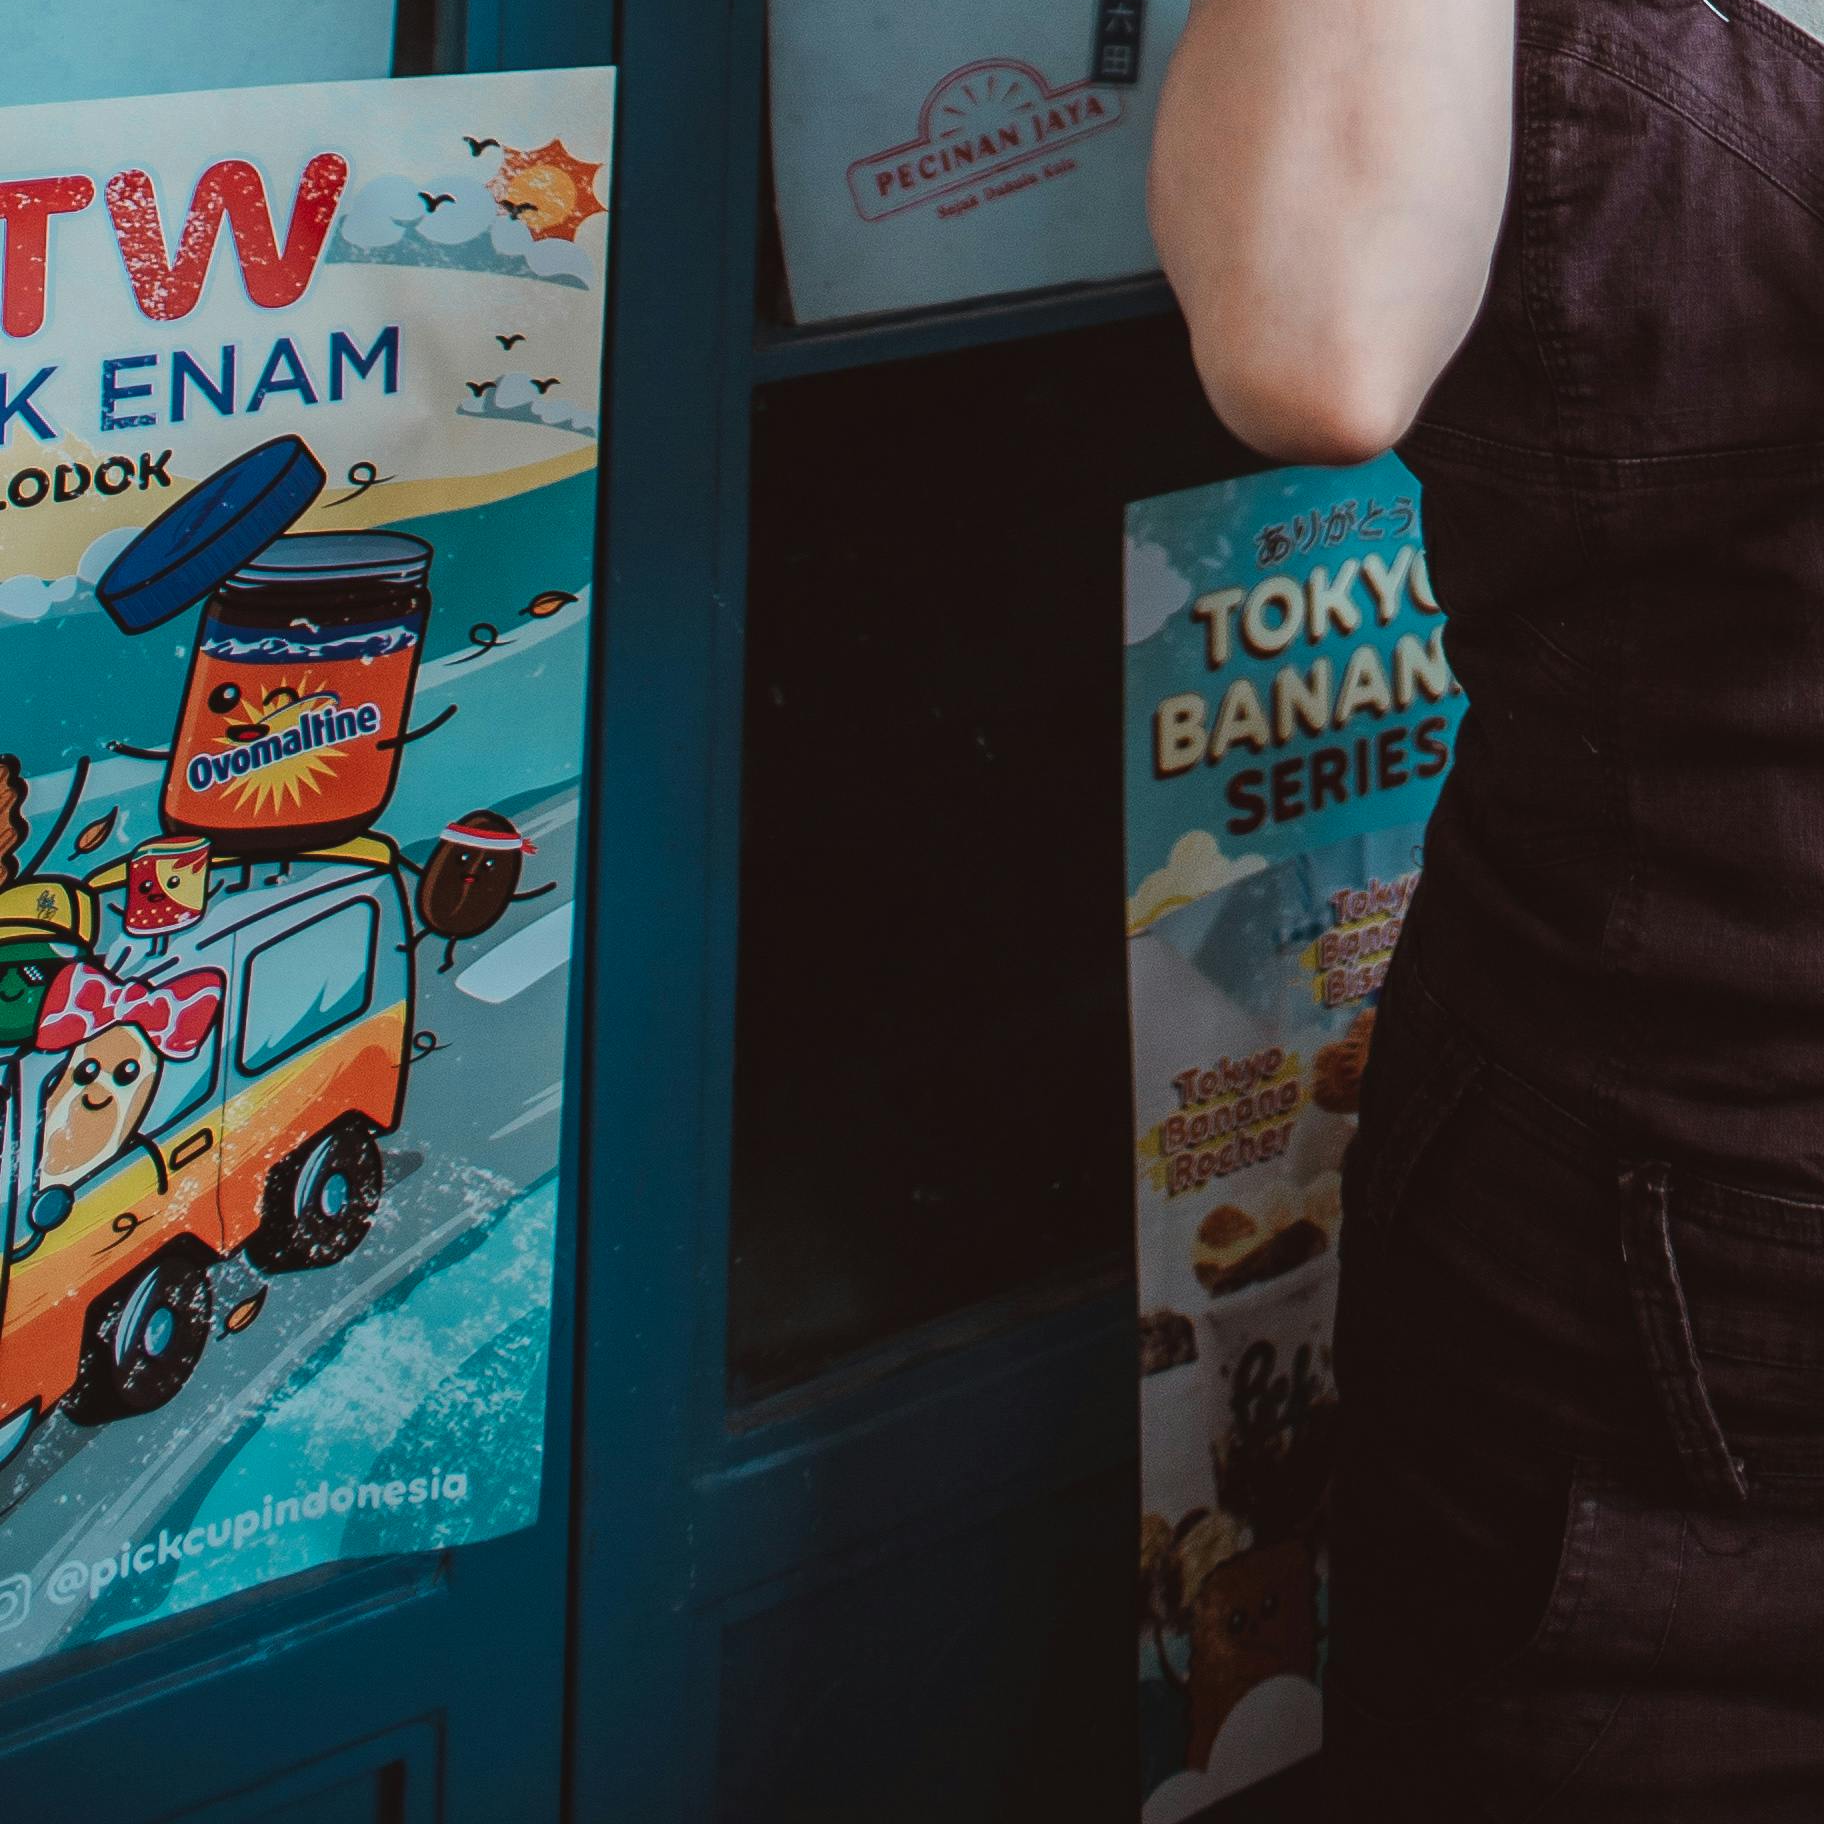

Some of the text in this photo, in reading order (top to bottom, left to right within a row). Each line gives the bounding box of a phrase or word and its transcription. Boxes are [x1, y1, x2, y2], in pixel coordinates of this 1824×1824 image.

[875, 95, 1105, 198] PECINAN JAYA
[101, 326, 400, 432] ENAM
[0, 449, 173, 510] ODOK
[1255, 496, 1416, 570] ありがとう
[186, 702, 382, 793] Ovomaltine
[1153, 623, 1463, 780] BANAN
[1225, 715, 1452, 836] SERIES
[1161, 1079, 1301, 1157] Banana
[1173, 1044, 1286, 1109] Tokyo
[46, 1468, 468, 1606] @pickcupindonesia
